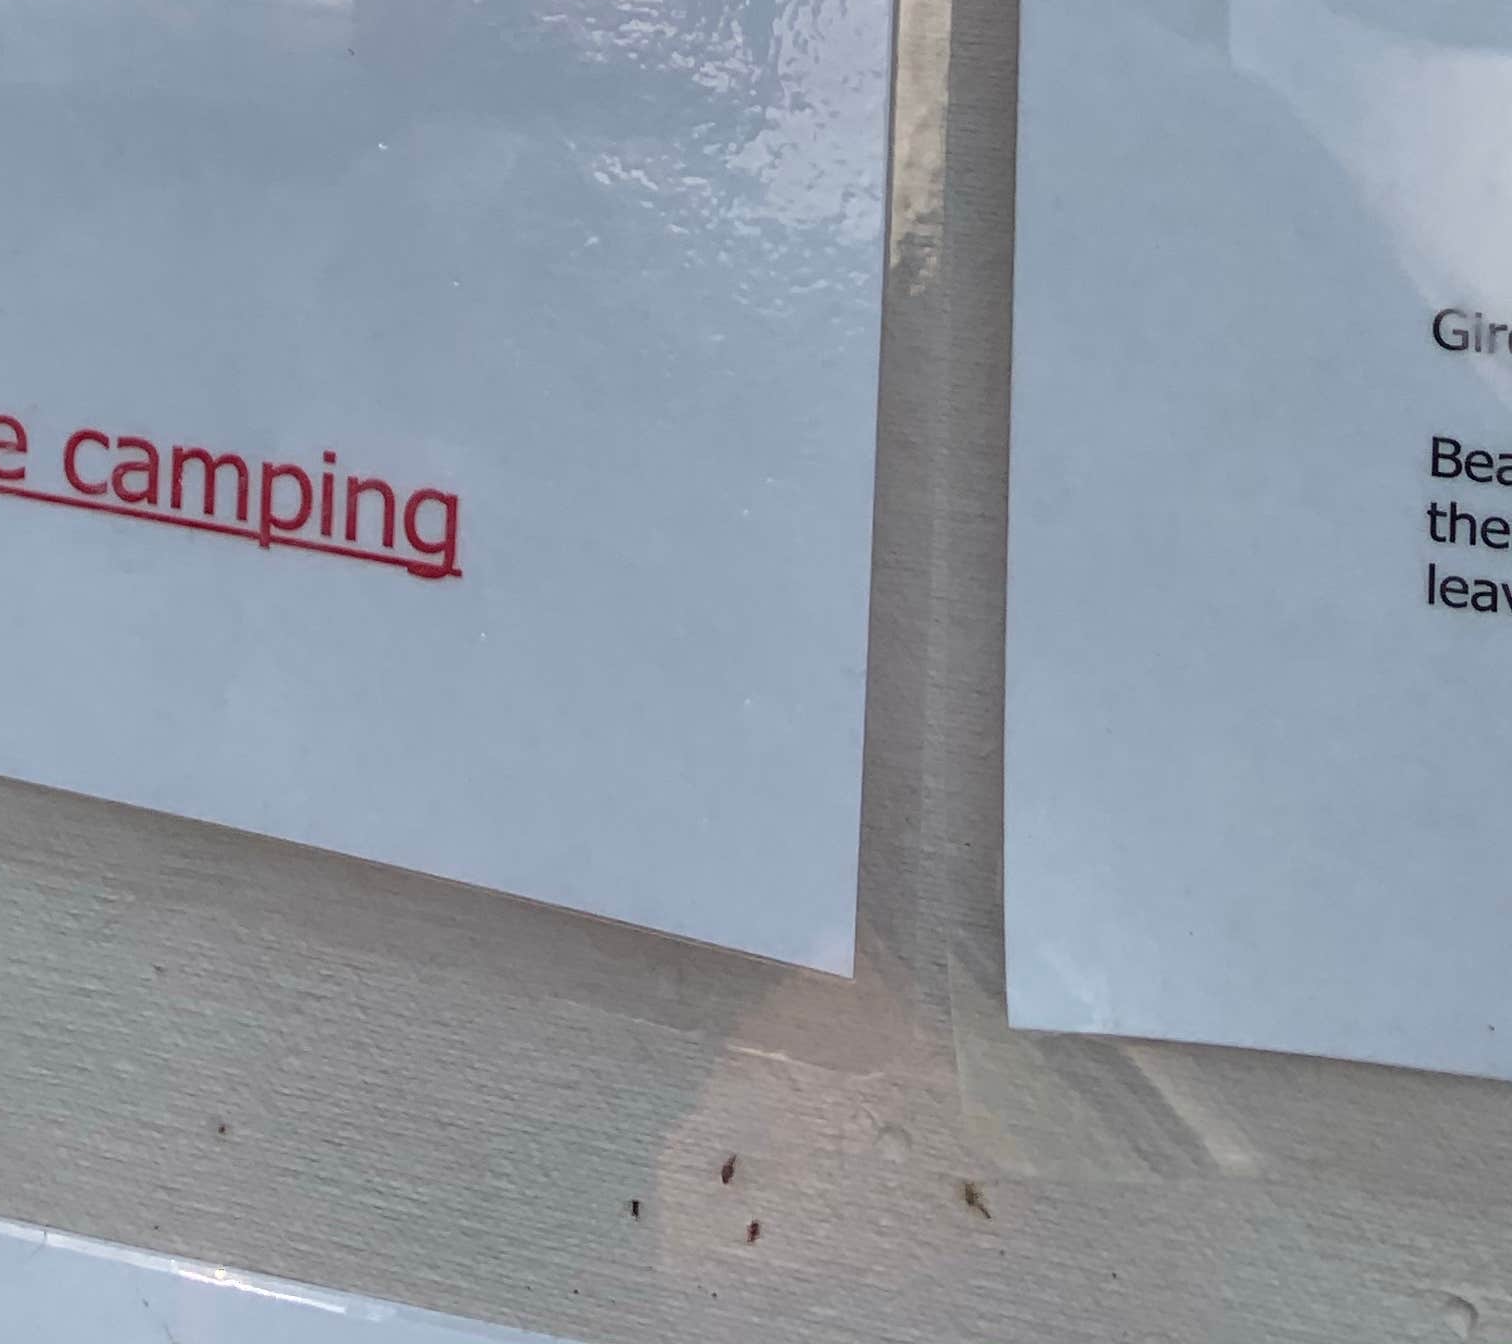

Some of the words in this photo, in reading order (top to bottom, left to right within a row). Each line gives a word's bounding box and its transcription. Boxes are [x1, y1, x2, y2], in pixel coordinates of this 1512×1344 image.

[1432, 308, 1512, 354] Gir
[63, 425, 462, 578] camping
[1426, 501, 1510, 550] the
